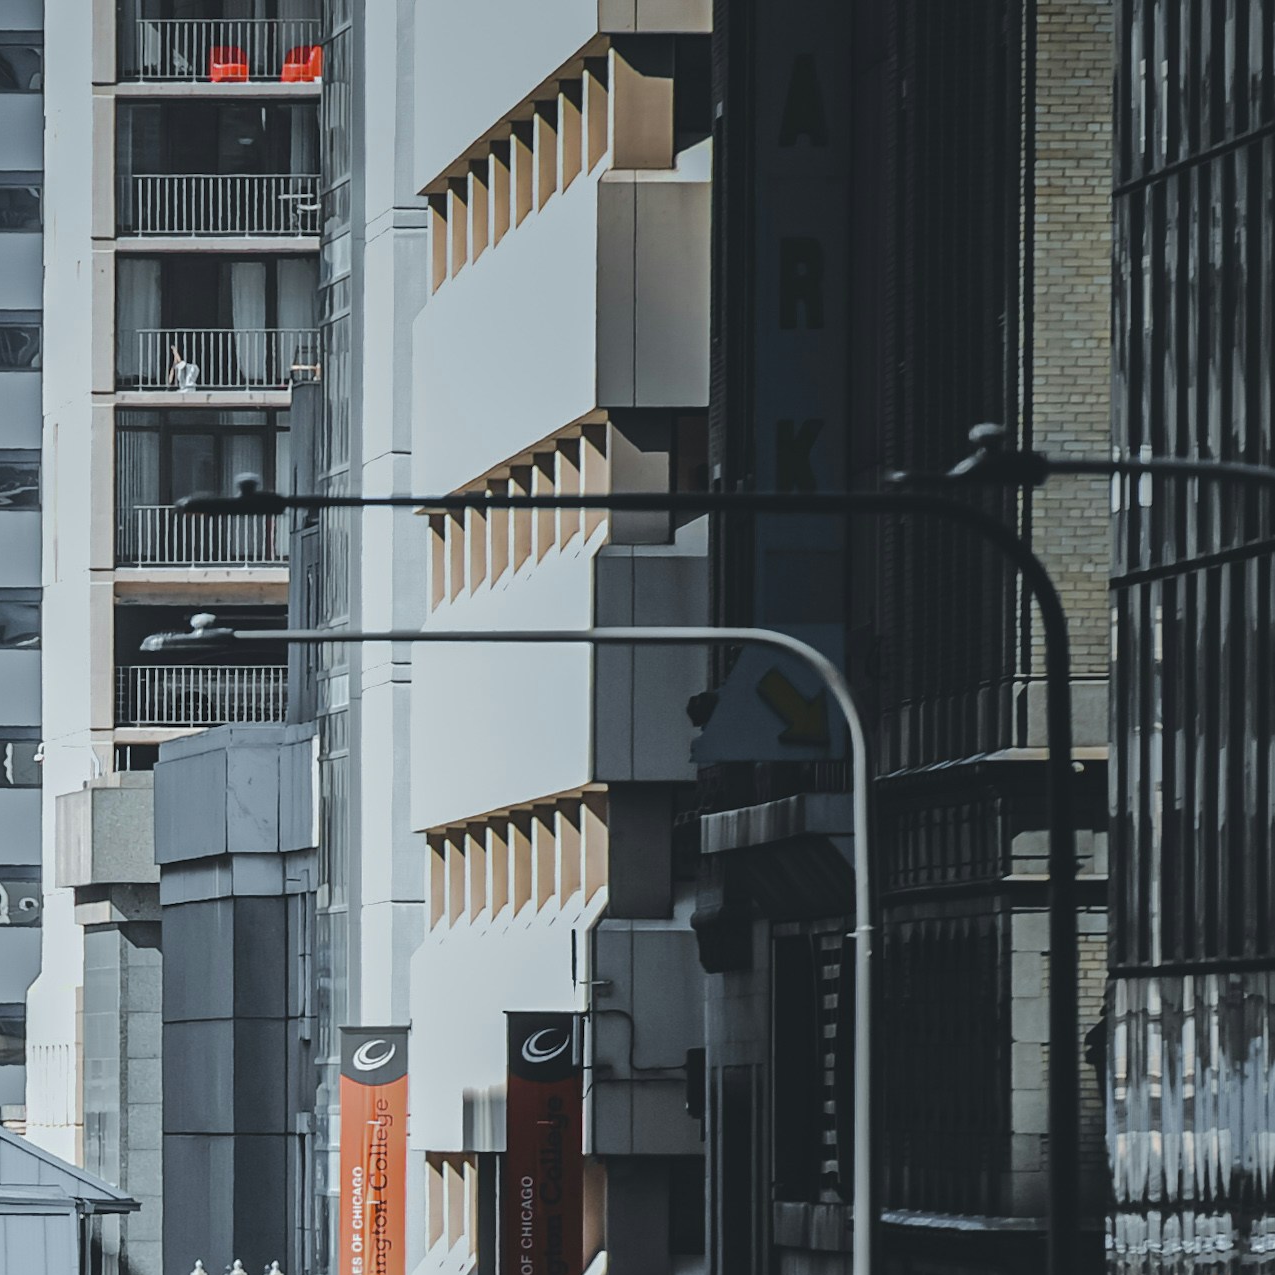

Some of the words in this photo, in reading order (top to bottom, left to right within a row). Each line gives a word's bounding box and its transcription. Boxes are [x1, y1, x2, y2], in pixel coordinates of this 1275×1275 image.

[366, 1098, 393, 1191] College
[352, 1167, 364, 1229] CHICAGO
[520, 1176, 533, 1250] CHICAGO
[351, 1232, 364, 1253] OF
[520, 1255, 533, 1275] OF
